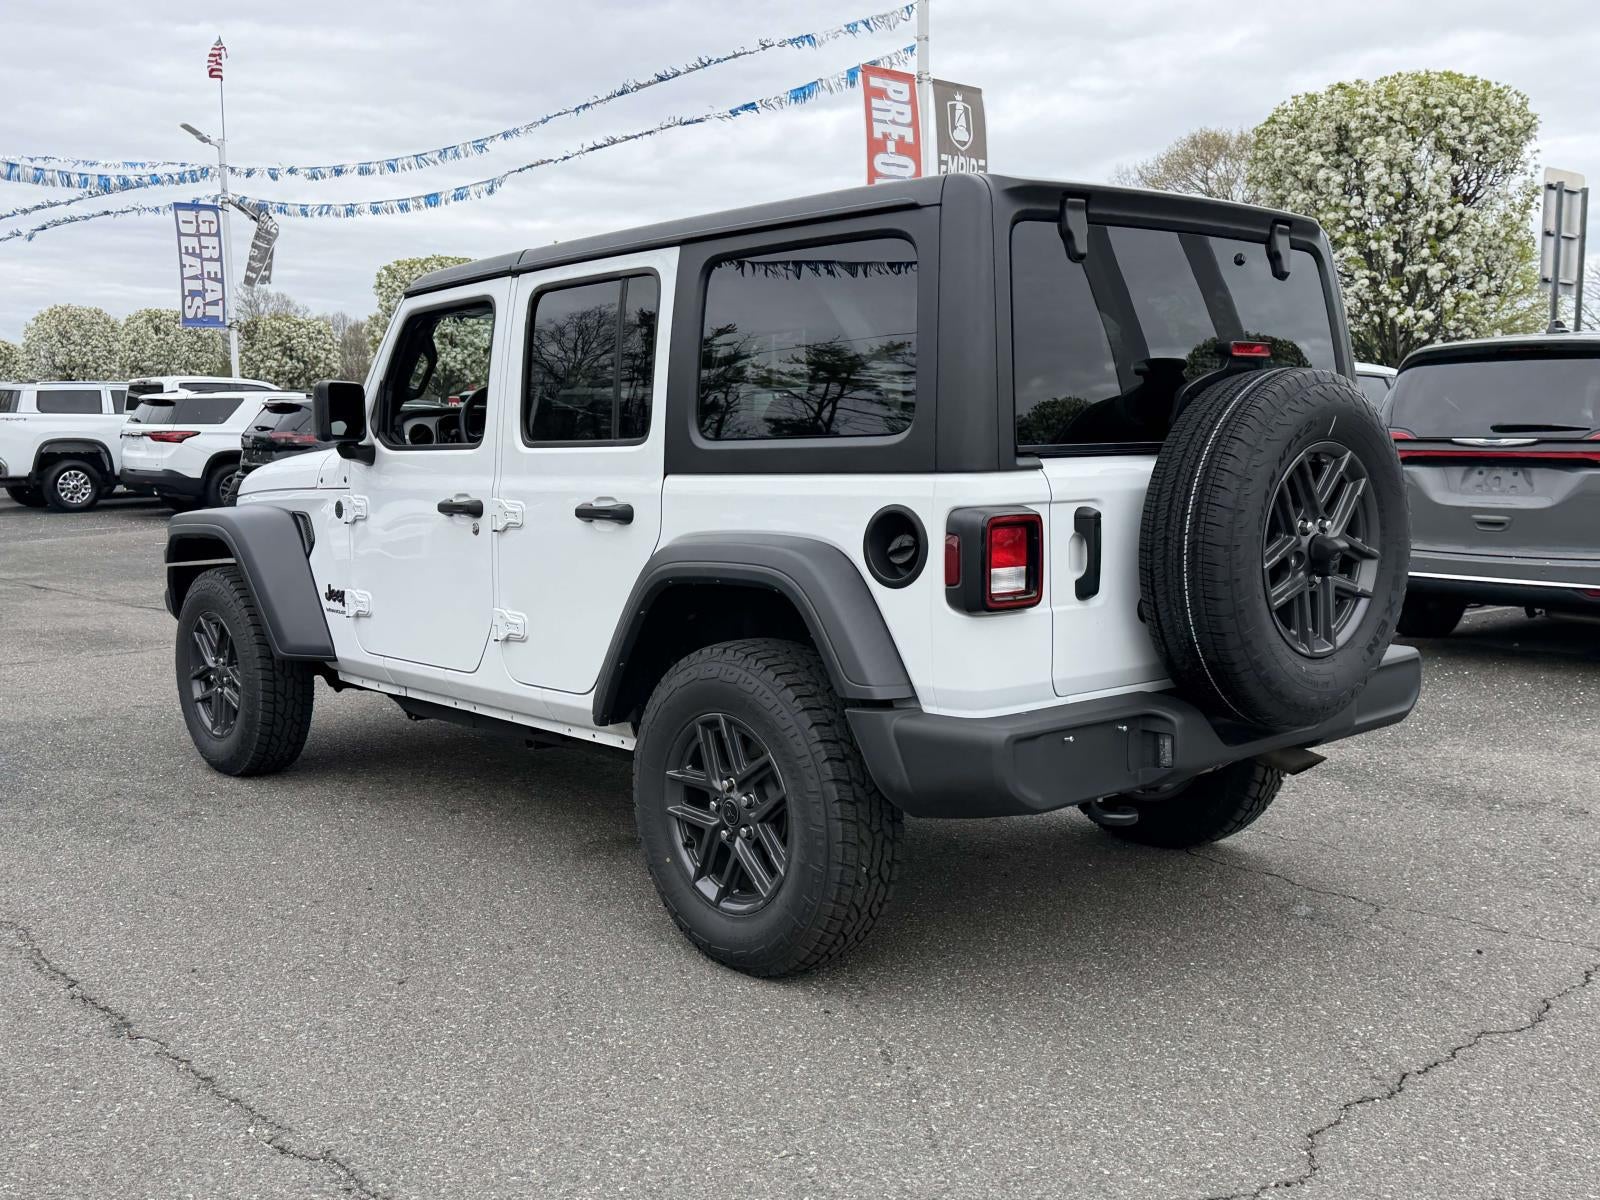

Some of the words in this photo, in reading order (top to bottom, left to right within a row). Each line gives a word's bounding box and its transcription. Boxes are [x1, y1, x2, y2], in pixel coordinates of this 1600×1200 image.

[869, 75, 916, 185] PRE-O
[177, 210, 205, 319] DEALS
[200, 209, 223, 322] GREAT
[325, 584, 346, 607] Jeep
